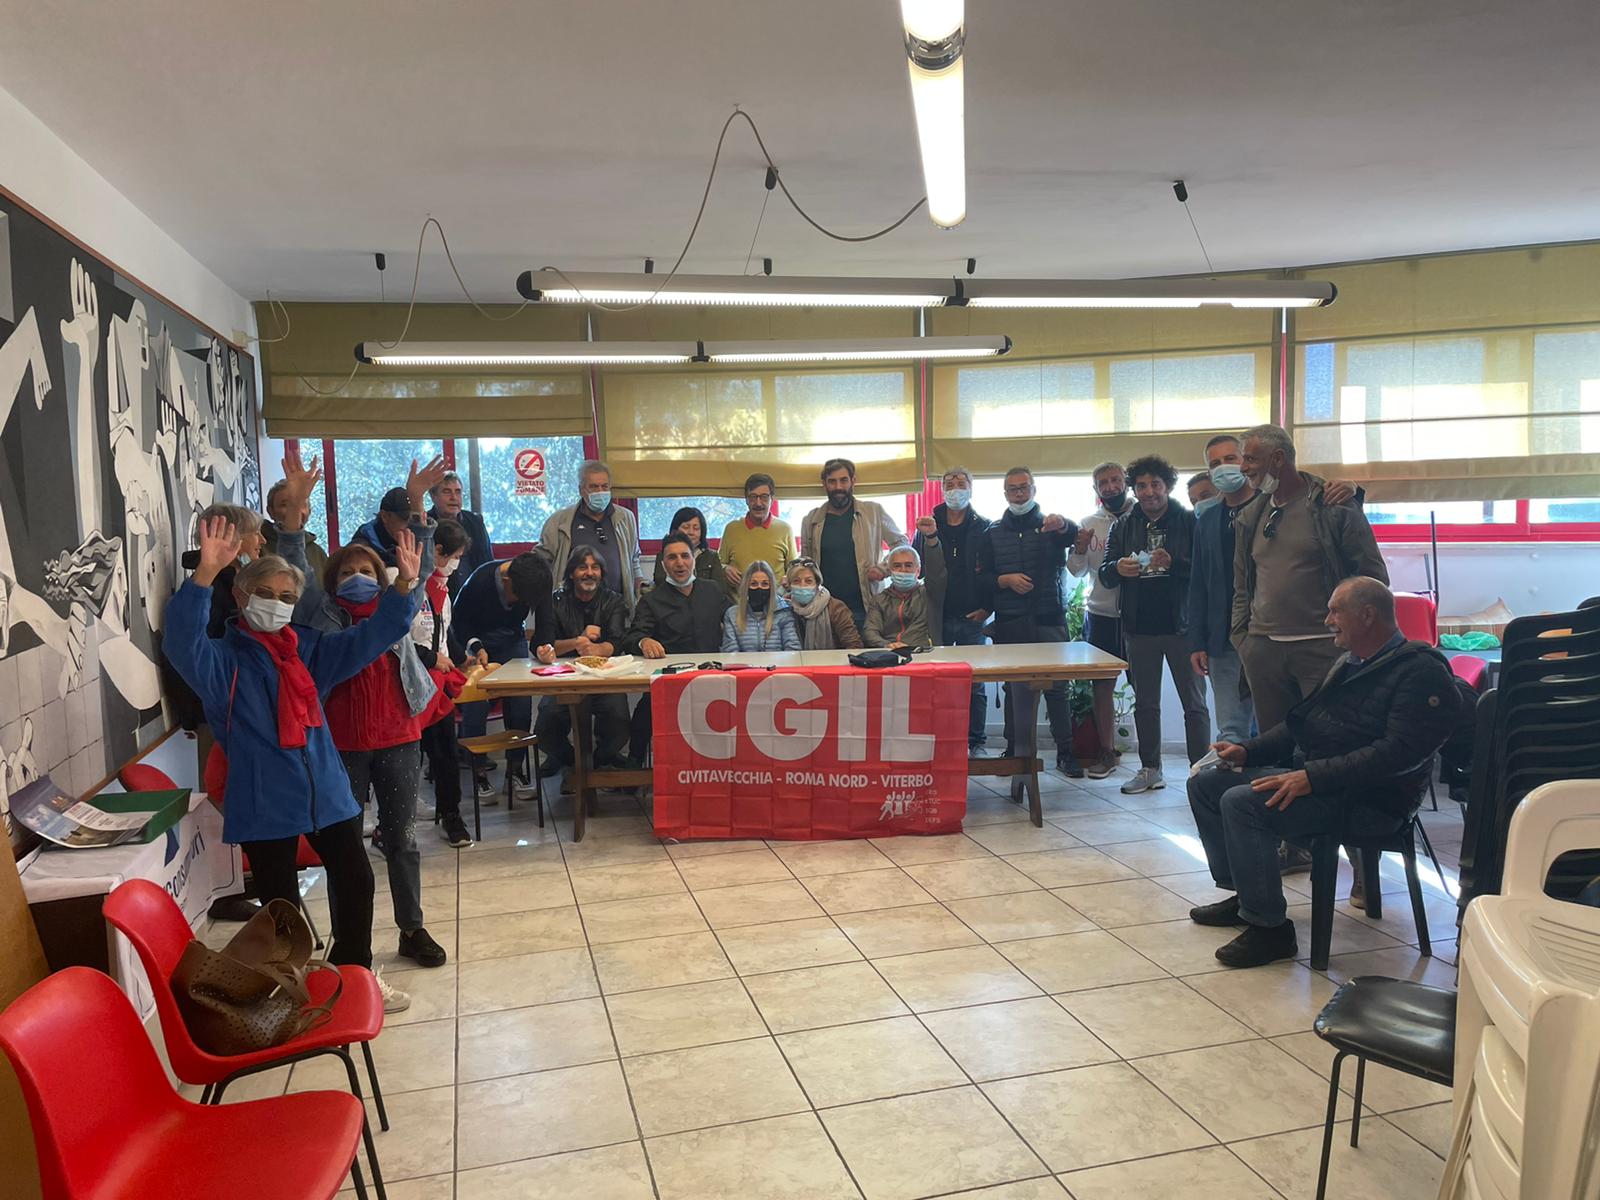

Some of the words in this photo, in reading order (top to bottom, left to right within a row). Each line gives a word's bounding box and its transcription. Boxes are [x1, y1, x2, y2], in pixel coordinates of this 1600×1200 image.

[677, 673, 936, 761] CGIL
[677, 770, 773, 785] CIVITAVECCHIA
[785, 772, 825, 786] ROMA
[829, 774, 868, 788] NORD
[880, 774, 933, 788] VITERBO
